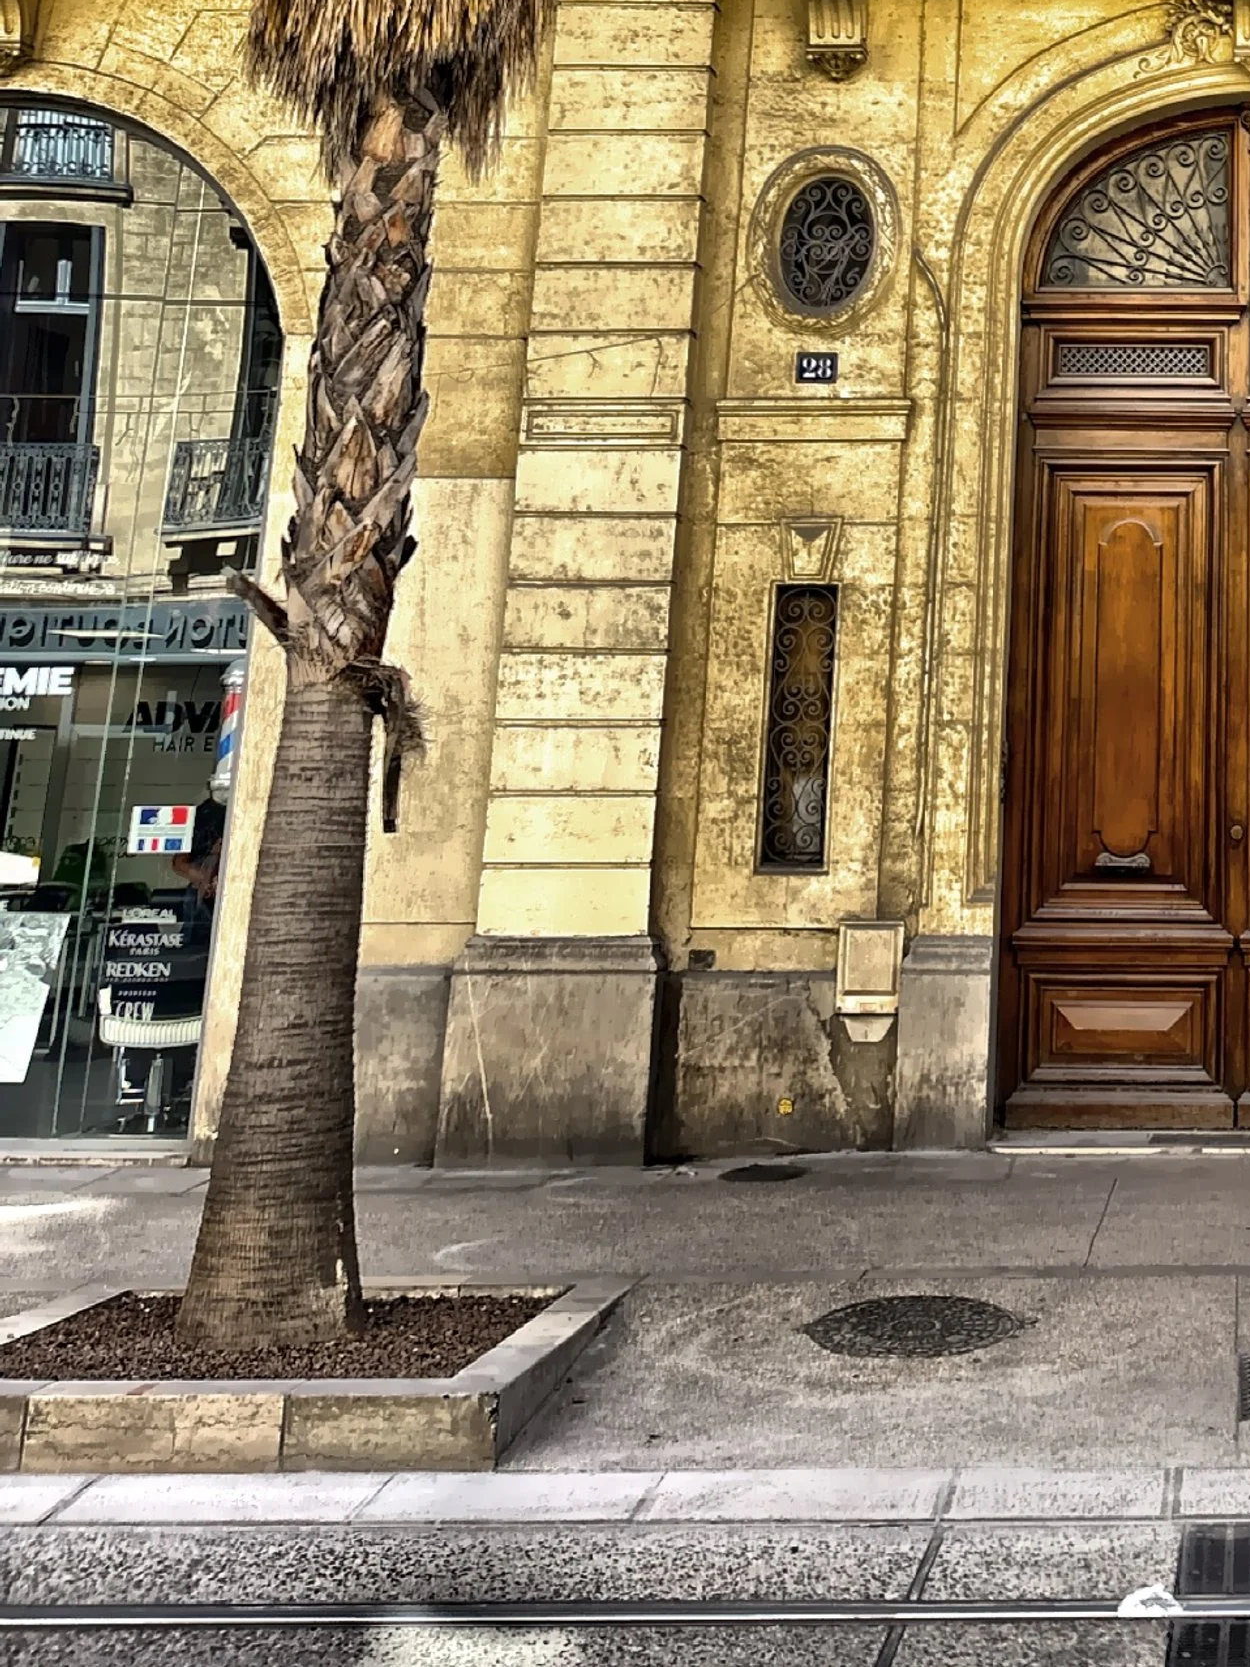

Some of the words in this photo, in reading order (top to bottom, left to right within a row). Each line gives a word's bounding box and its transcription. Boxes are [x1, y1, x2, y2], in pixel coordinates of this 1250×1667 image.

[802, 358, 832, 379] 28
[153, 736, 195, 753] HAIR
[105, 961, 172, 978] REDKEN
